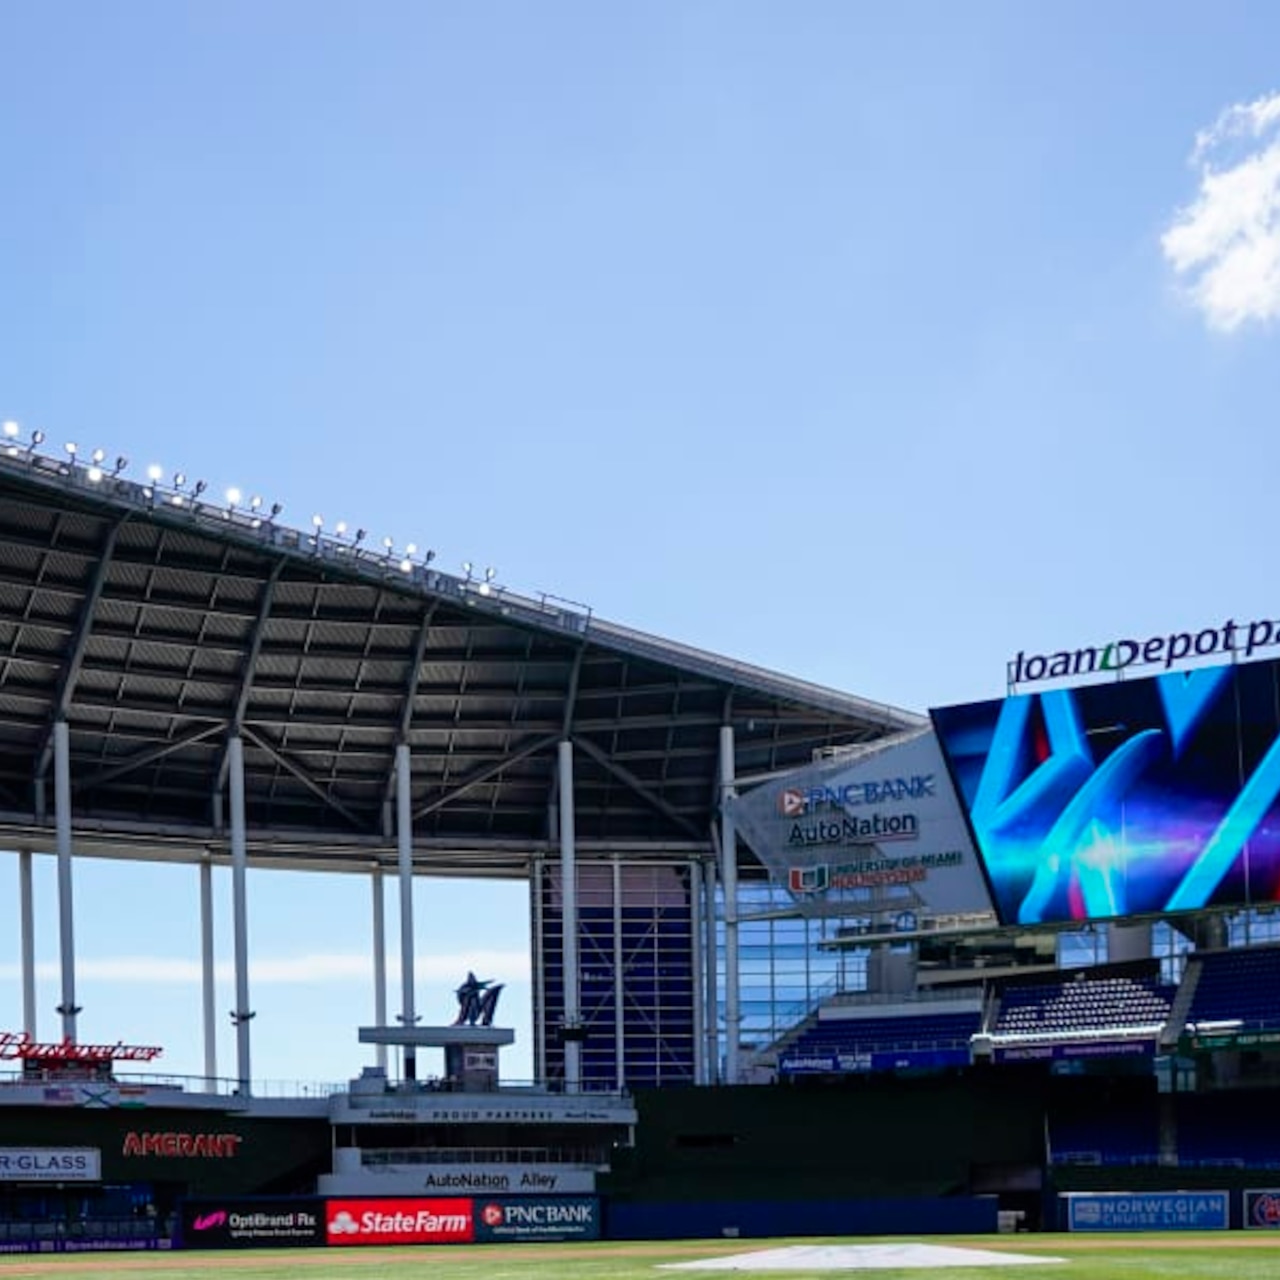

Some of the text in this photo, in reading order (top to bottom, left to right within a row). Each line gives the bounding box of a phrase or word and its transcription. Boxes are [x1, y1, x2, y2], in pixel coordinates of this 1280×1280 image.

[1014, 620, 1239, 682] loanDepot
[789, 814, 918, 843] AutoNation
[122, 1131, 239, 1158] AMERANT
[426, 1172, 558, 1189] AutoNation Alley
[1102, 1199, 1221, 1213] NORWEGIAN
[1102, 1213, 1196, 1224] CRUISE LINE
